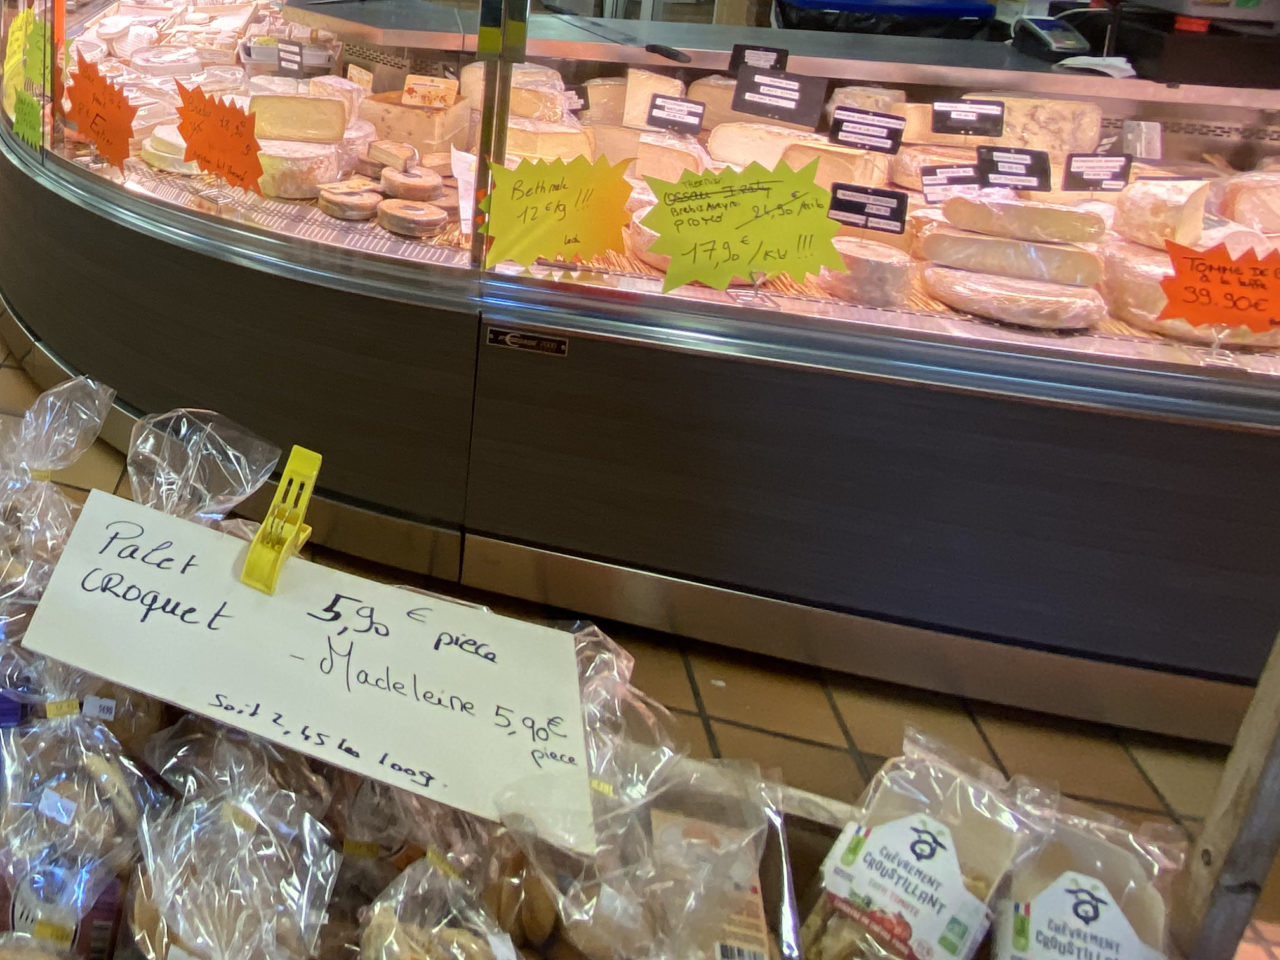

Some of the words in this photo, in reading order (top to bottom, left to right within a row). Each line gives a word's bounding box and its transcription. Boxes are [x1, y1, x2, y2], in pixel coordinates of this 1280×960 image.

[98, 520, 199, 574] Palet
[319, 635, 476, 717] Madeleine
[862, 851, 947, 915] CROUSTILLANT
